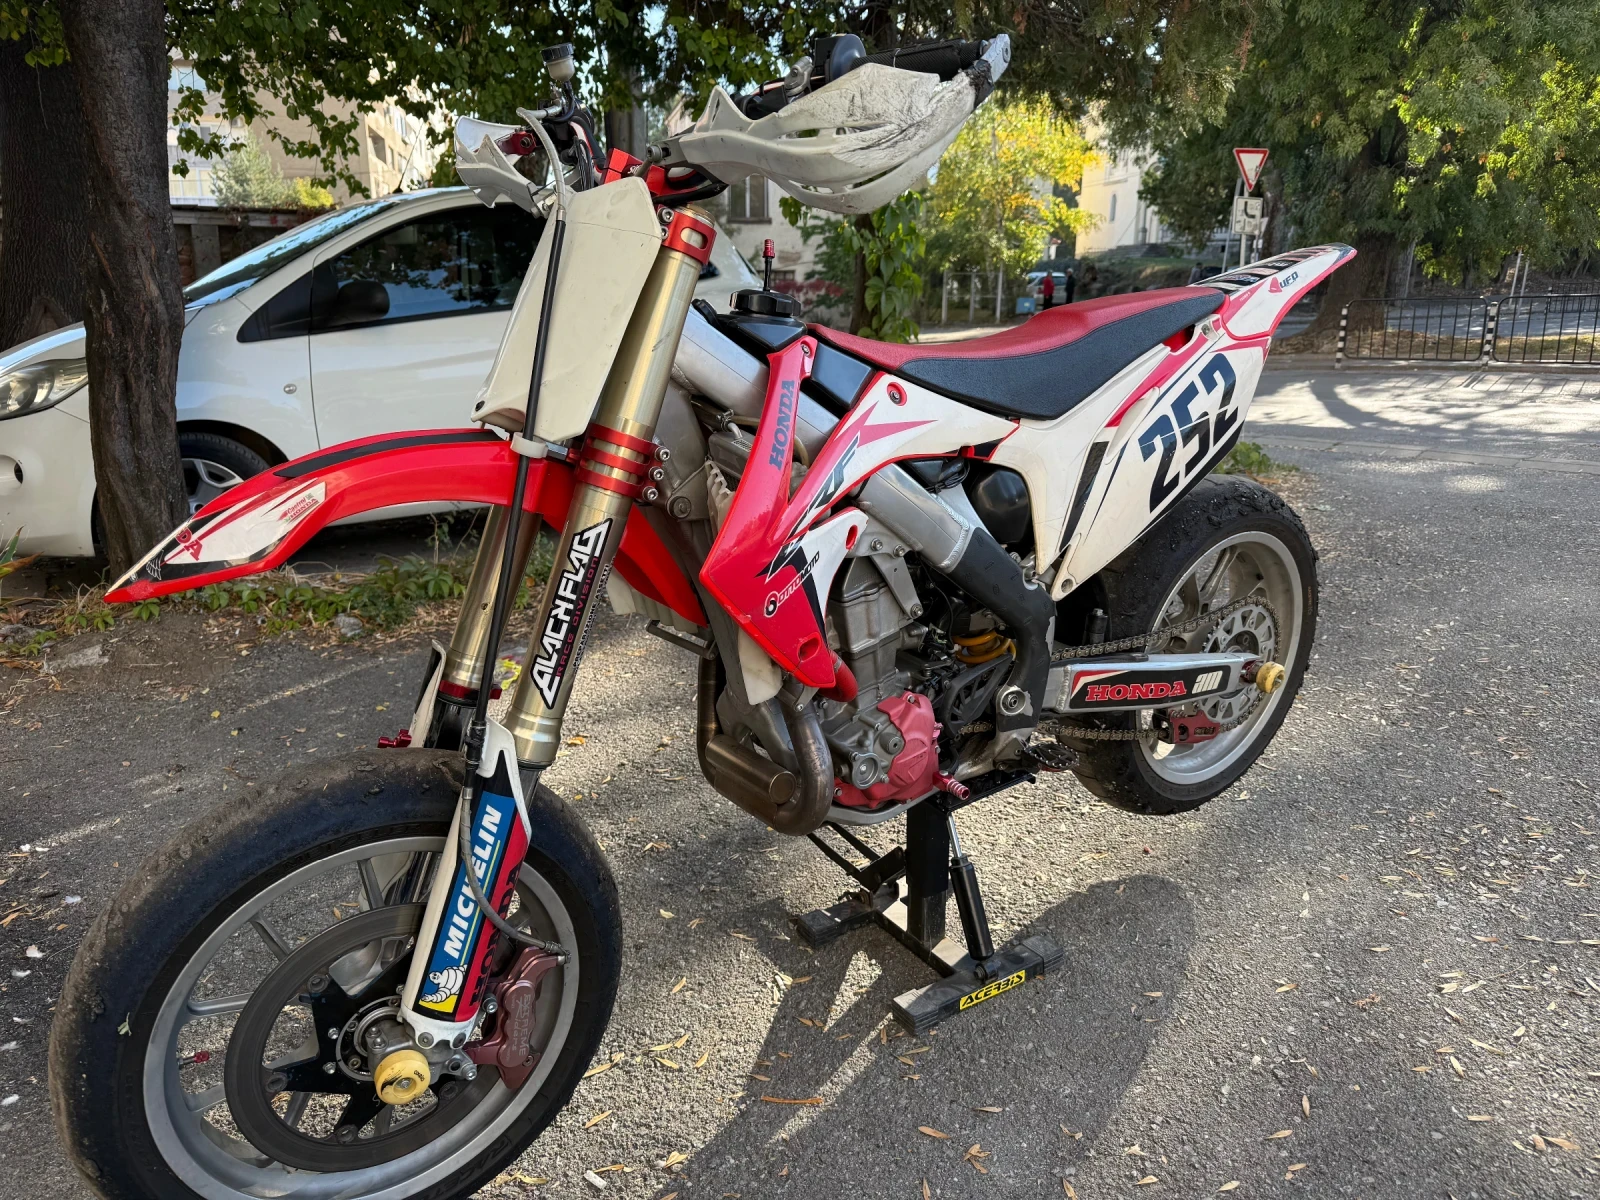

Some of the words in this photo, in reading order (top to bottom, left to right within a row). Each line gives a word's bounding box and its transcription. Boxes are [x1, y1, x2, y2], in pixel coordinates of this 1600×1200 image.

[1279, 271, 1299, 289] UFO
[769, 380, 795, 471] HONDA
[1138, 353, 1238, 513] 252
[555, 634, 575, 677] RACE
[572, 557, 599, 626] DIVISION
[1085, 680, 1187, 701] HONDA
[443, 804, 502, 959] MICHELIN
